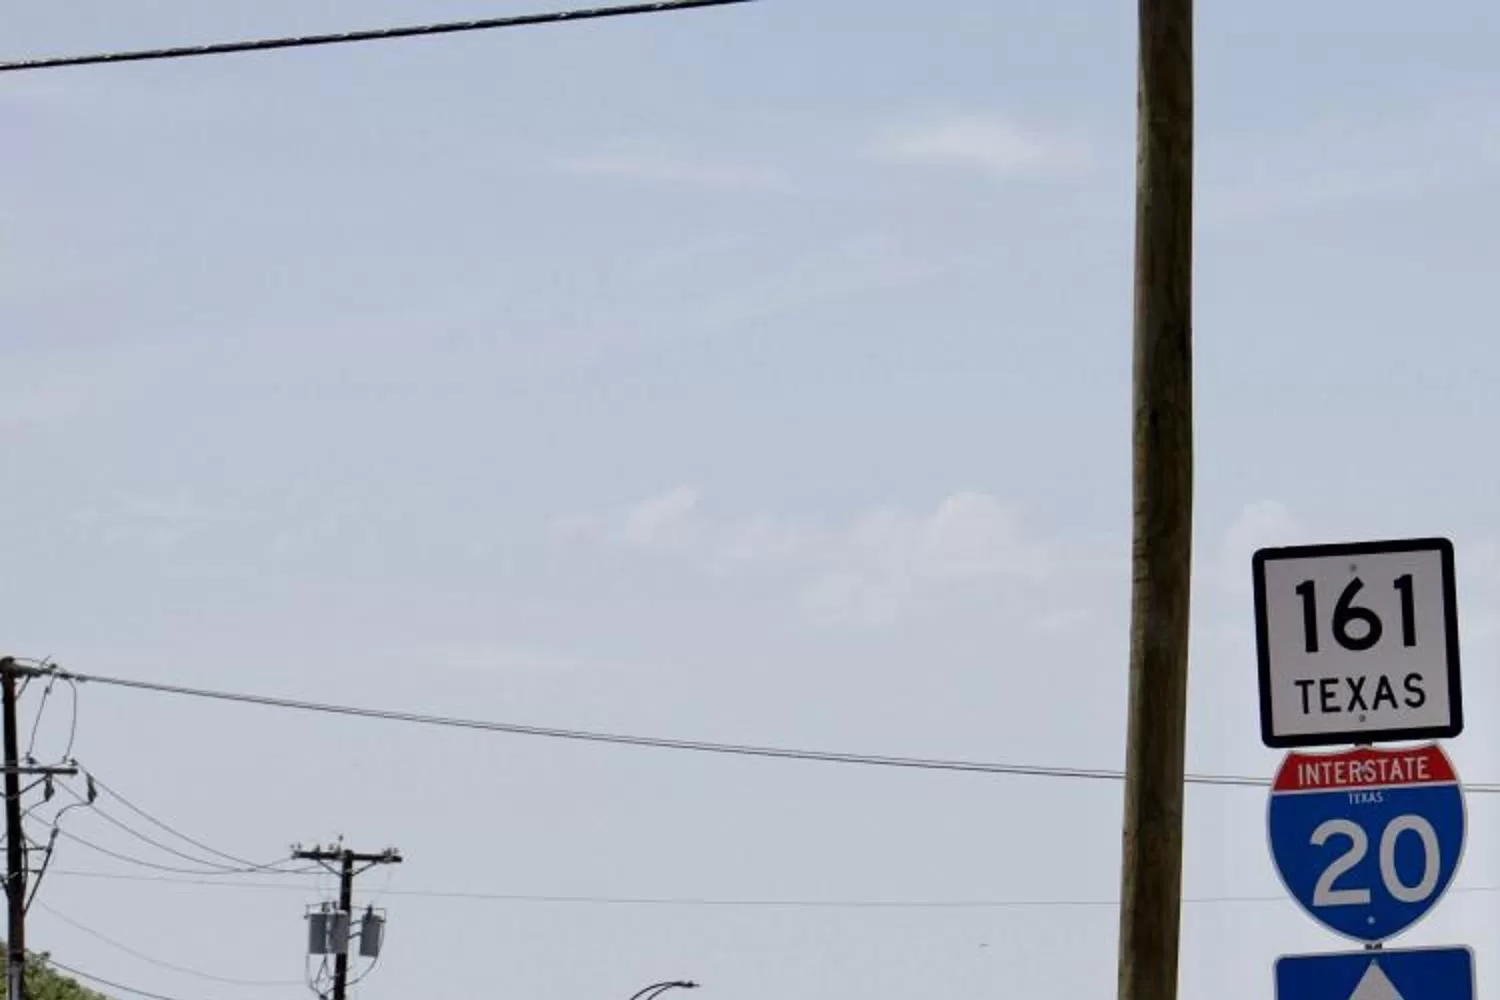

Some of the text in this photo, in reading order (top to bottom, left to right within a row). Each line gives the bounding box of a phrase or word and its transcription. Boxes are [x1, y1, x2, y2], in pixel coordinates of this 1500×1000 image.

[1295, 573, 1416, 653] 161
[1295, 672, 1426, 715] TEXAS
[1297, 756, 1431, 785] INTERSTATE
[1347, 791, 1384, 805] TEXAS
[1309, 815, 1440, 906] 20
